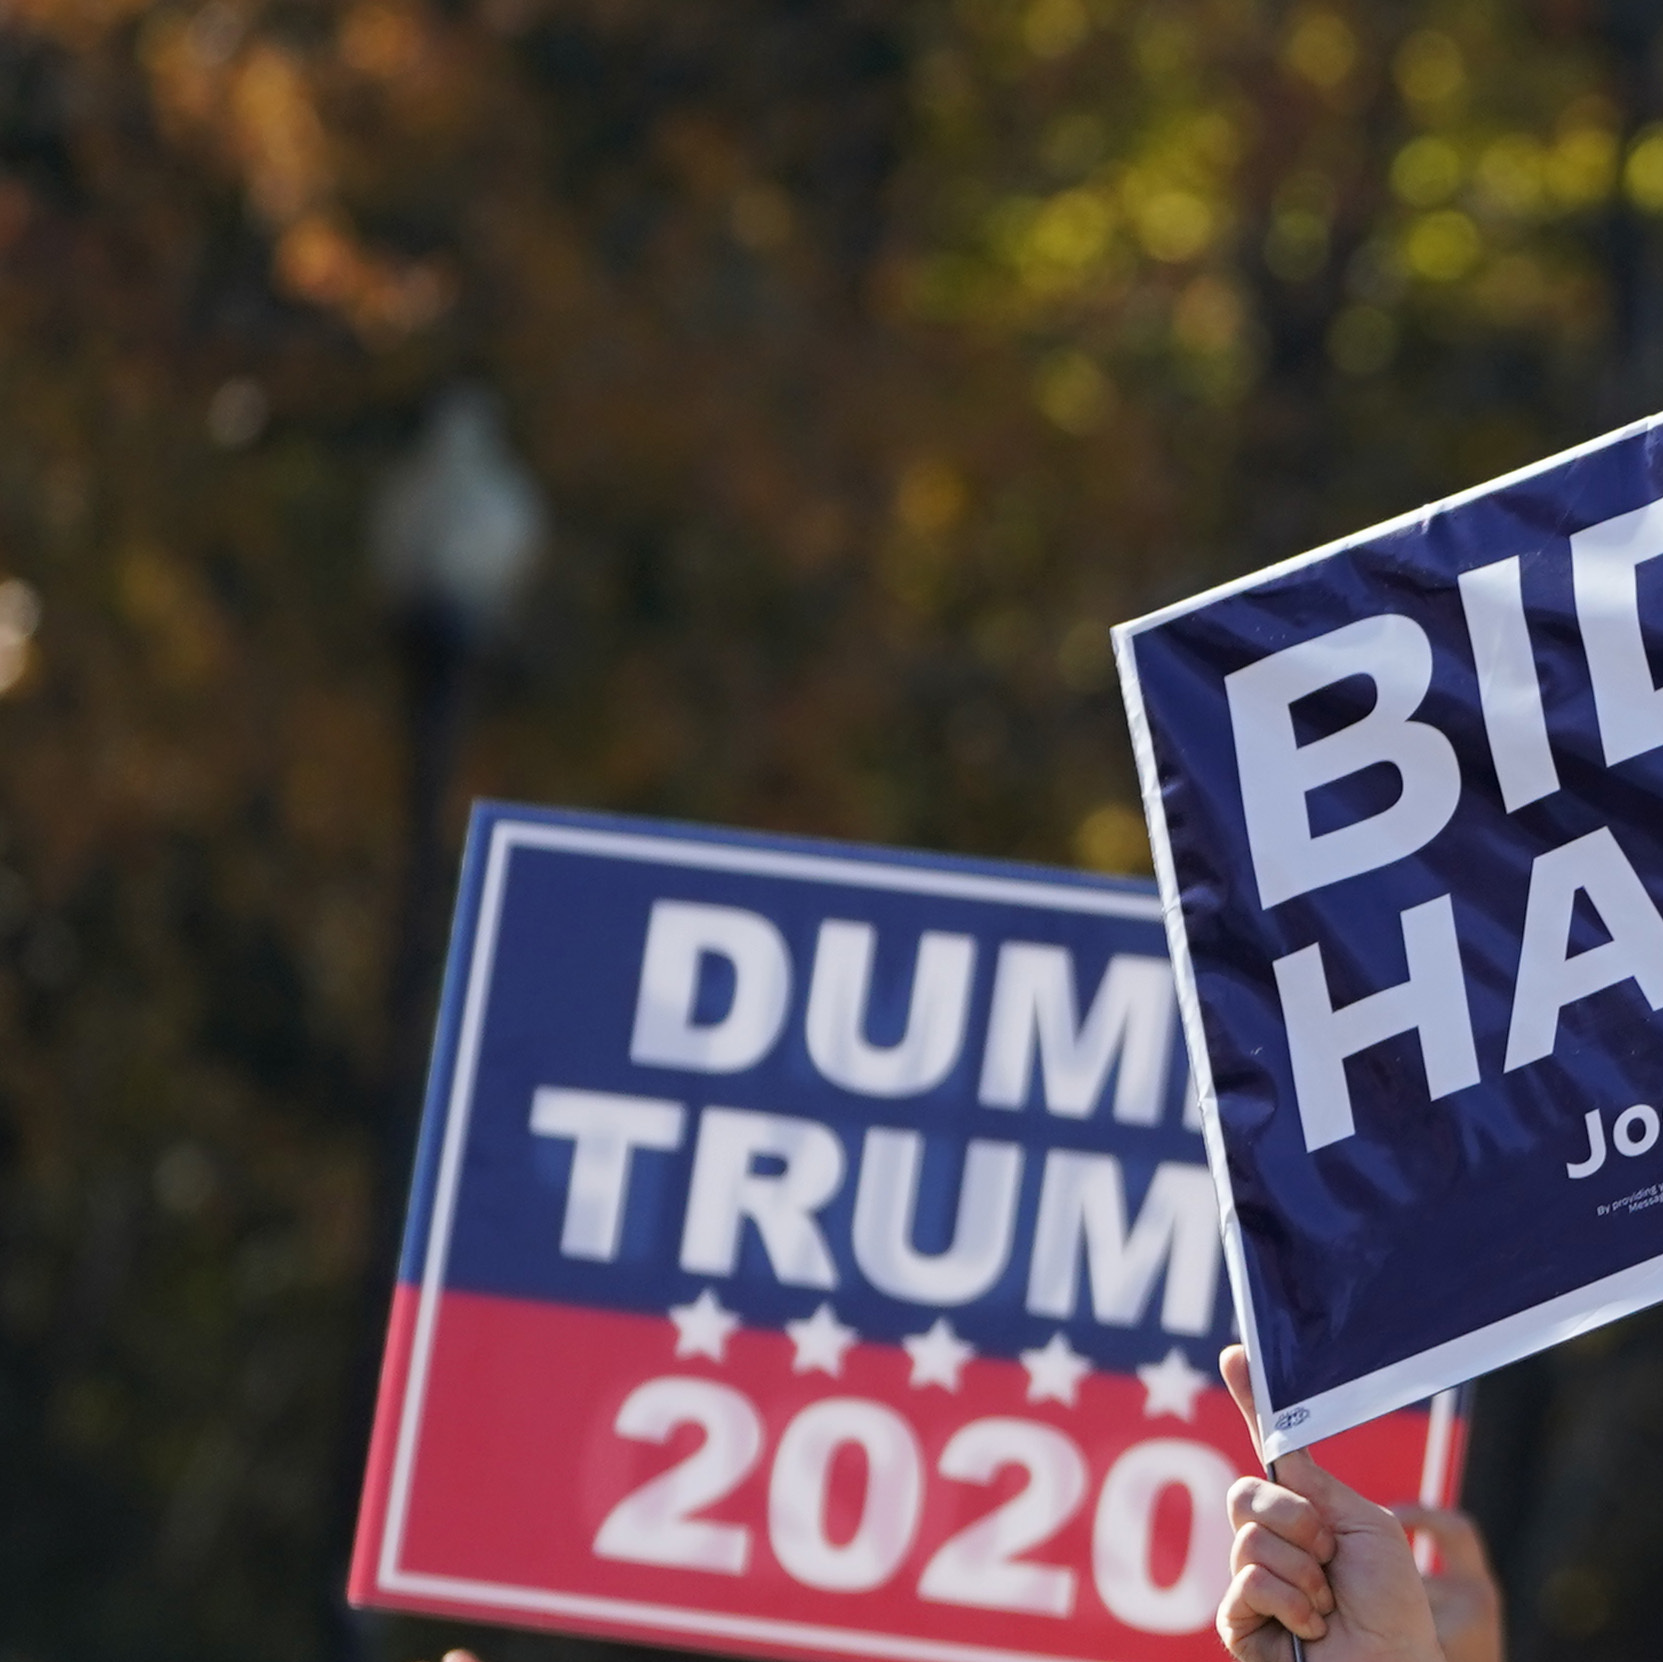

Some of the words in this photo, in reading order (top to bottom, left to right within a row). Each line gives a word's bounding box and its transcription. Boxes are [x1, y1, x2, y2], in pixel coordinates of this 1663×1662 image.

[629, 899, 1200, 1130] DUM
[529, 1086, 1246, 1337] TRUM
[1597, 1205, 1610, 1216] By
[1612, 1185, 1658, 1211] providing
[593, 1377, 1240, 1636] 2020
